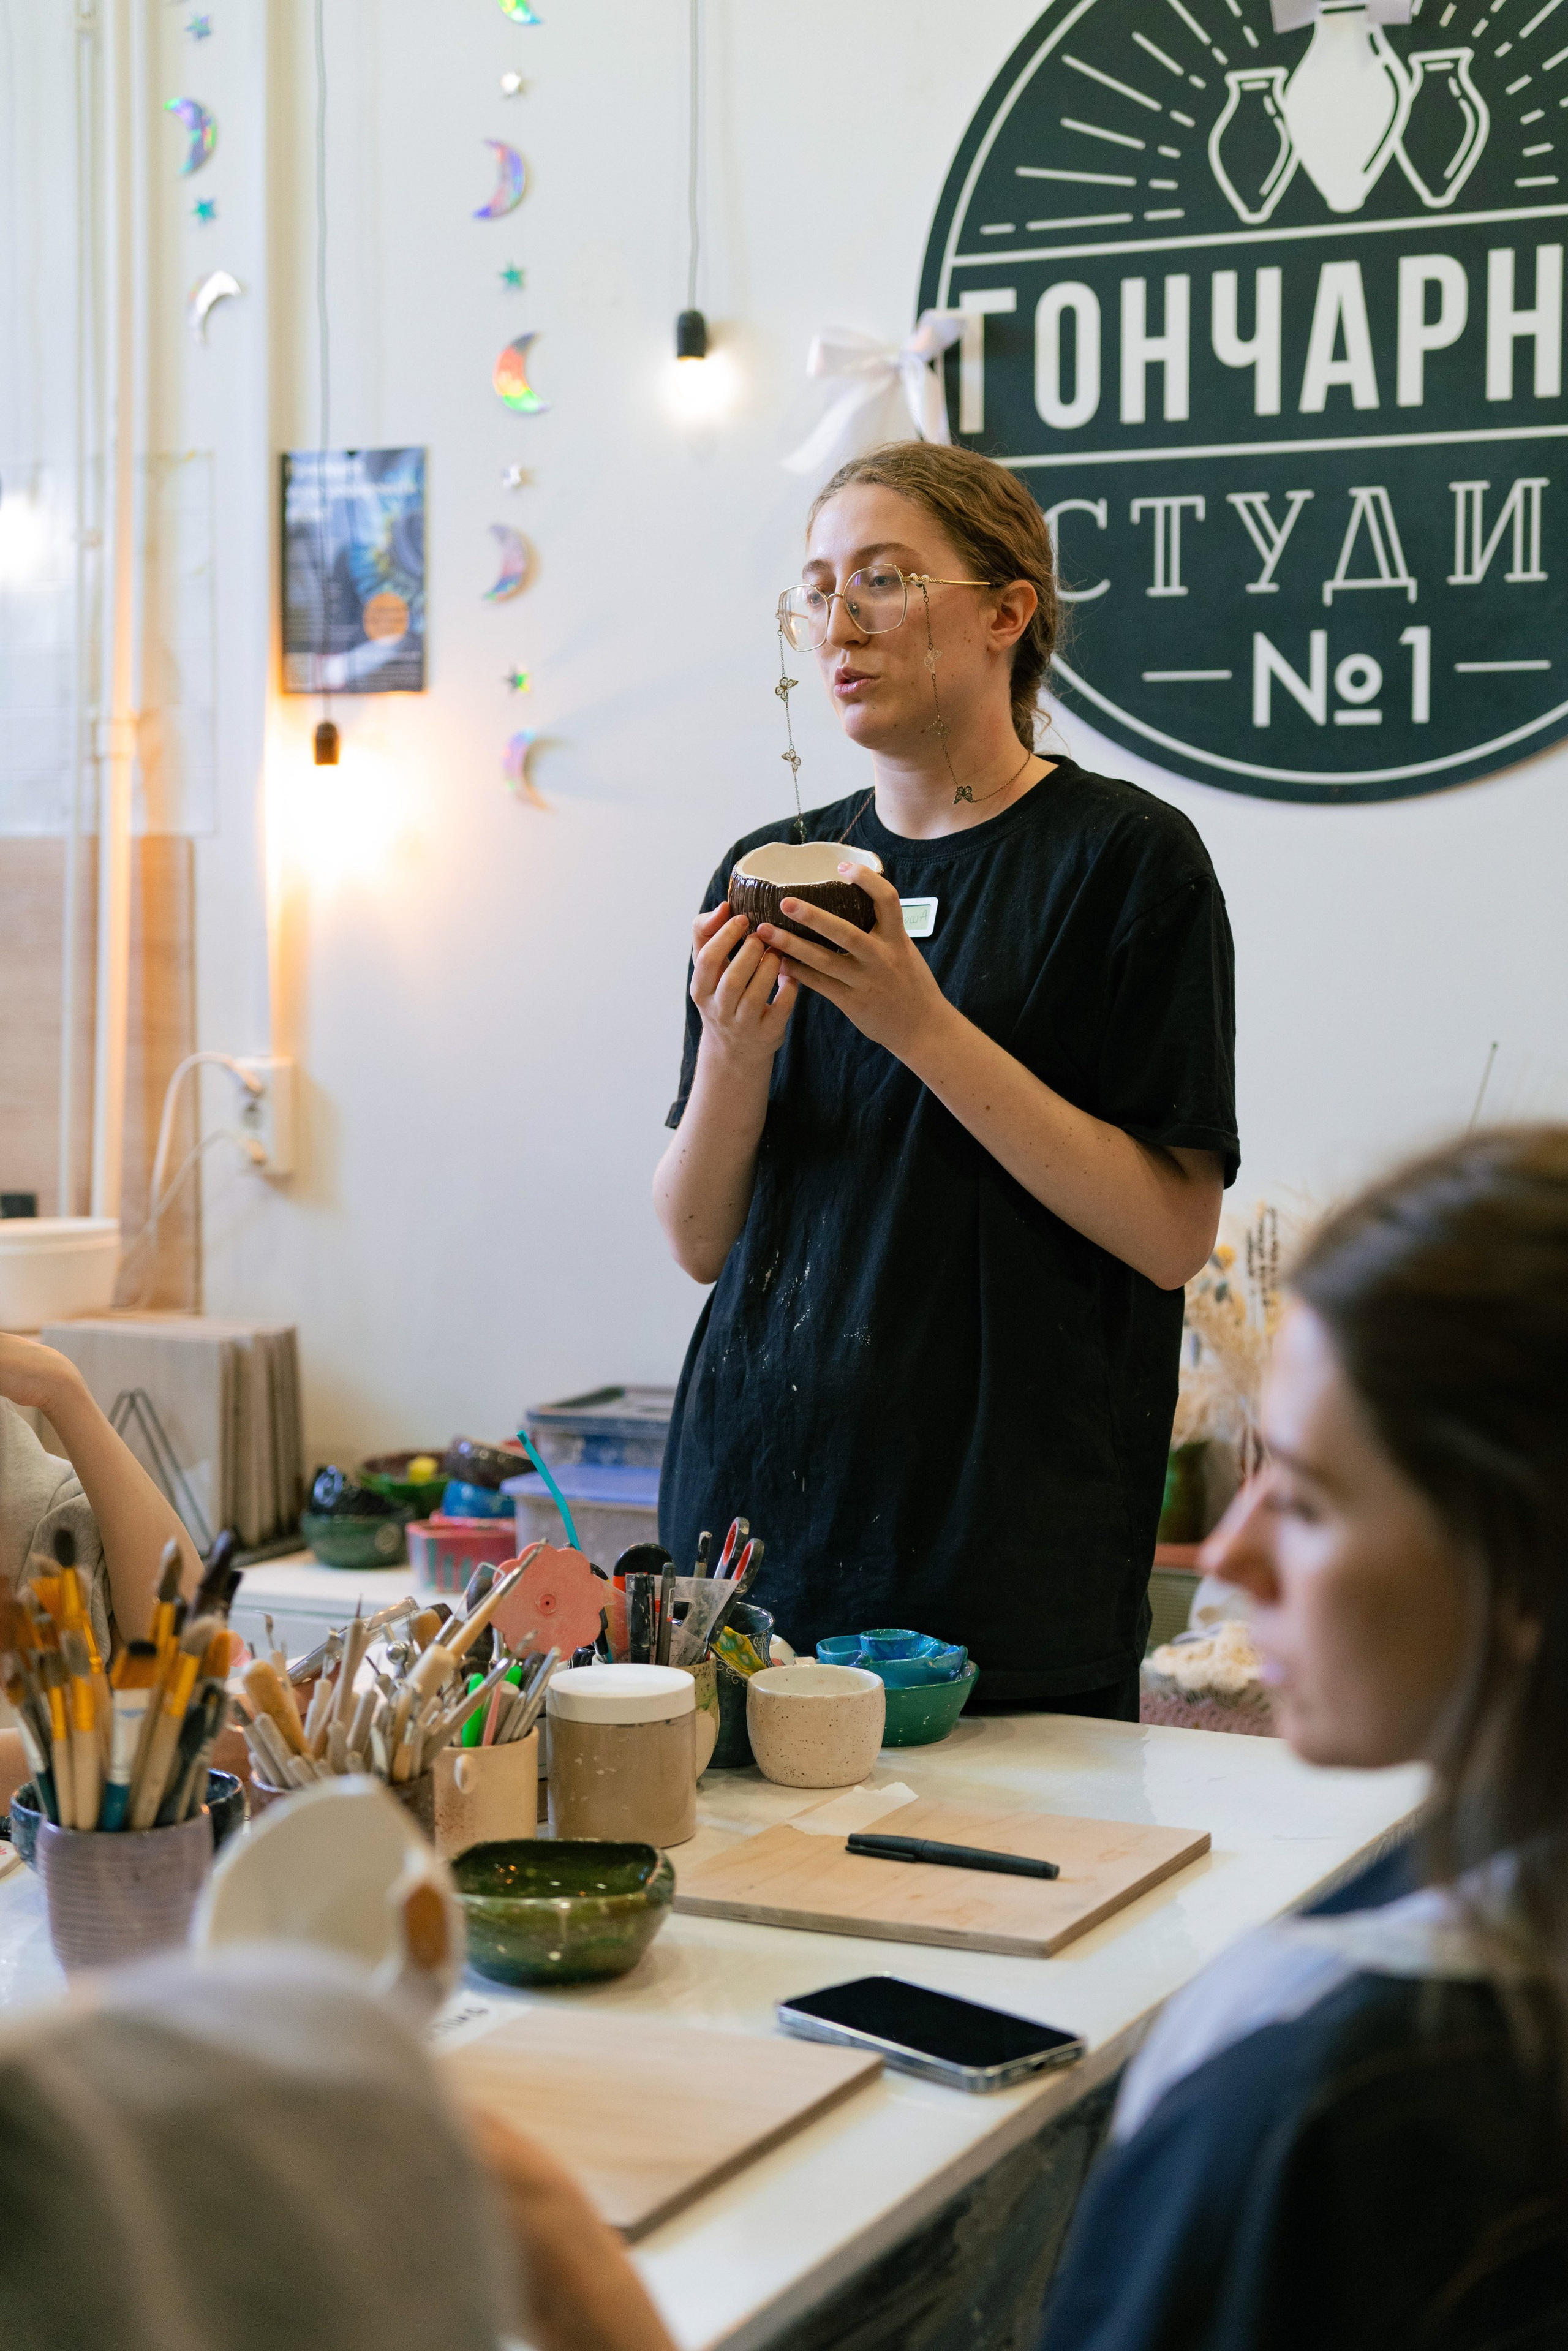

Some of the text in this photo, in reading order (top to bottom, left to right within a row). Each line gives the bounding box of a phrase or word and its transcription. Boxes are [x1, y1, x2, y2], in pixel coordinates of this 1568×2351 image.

[959, 243, 1564, 435] ГОНЧАРН
[1049, 477, 1550, 606] СТУДИ
[1252, 625, 1431, 728] №1
